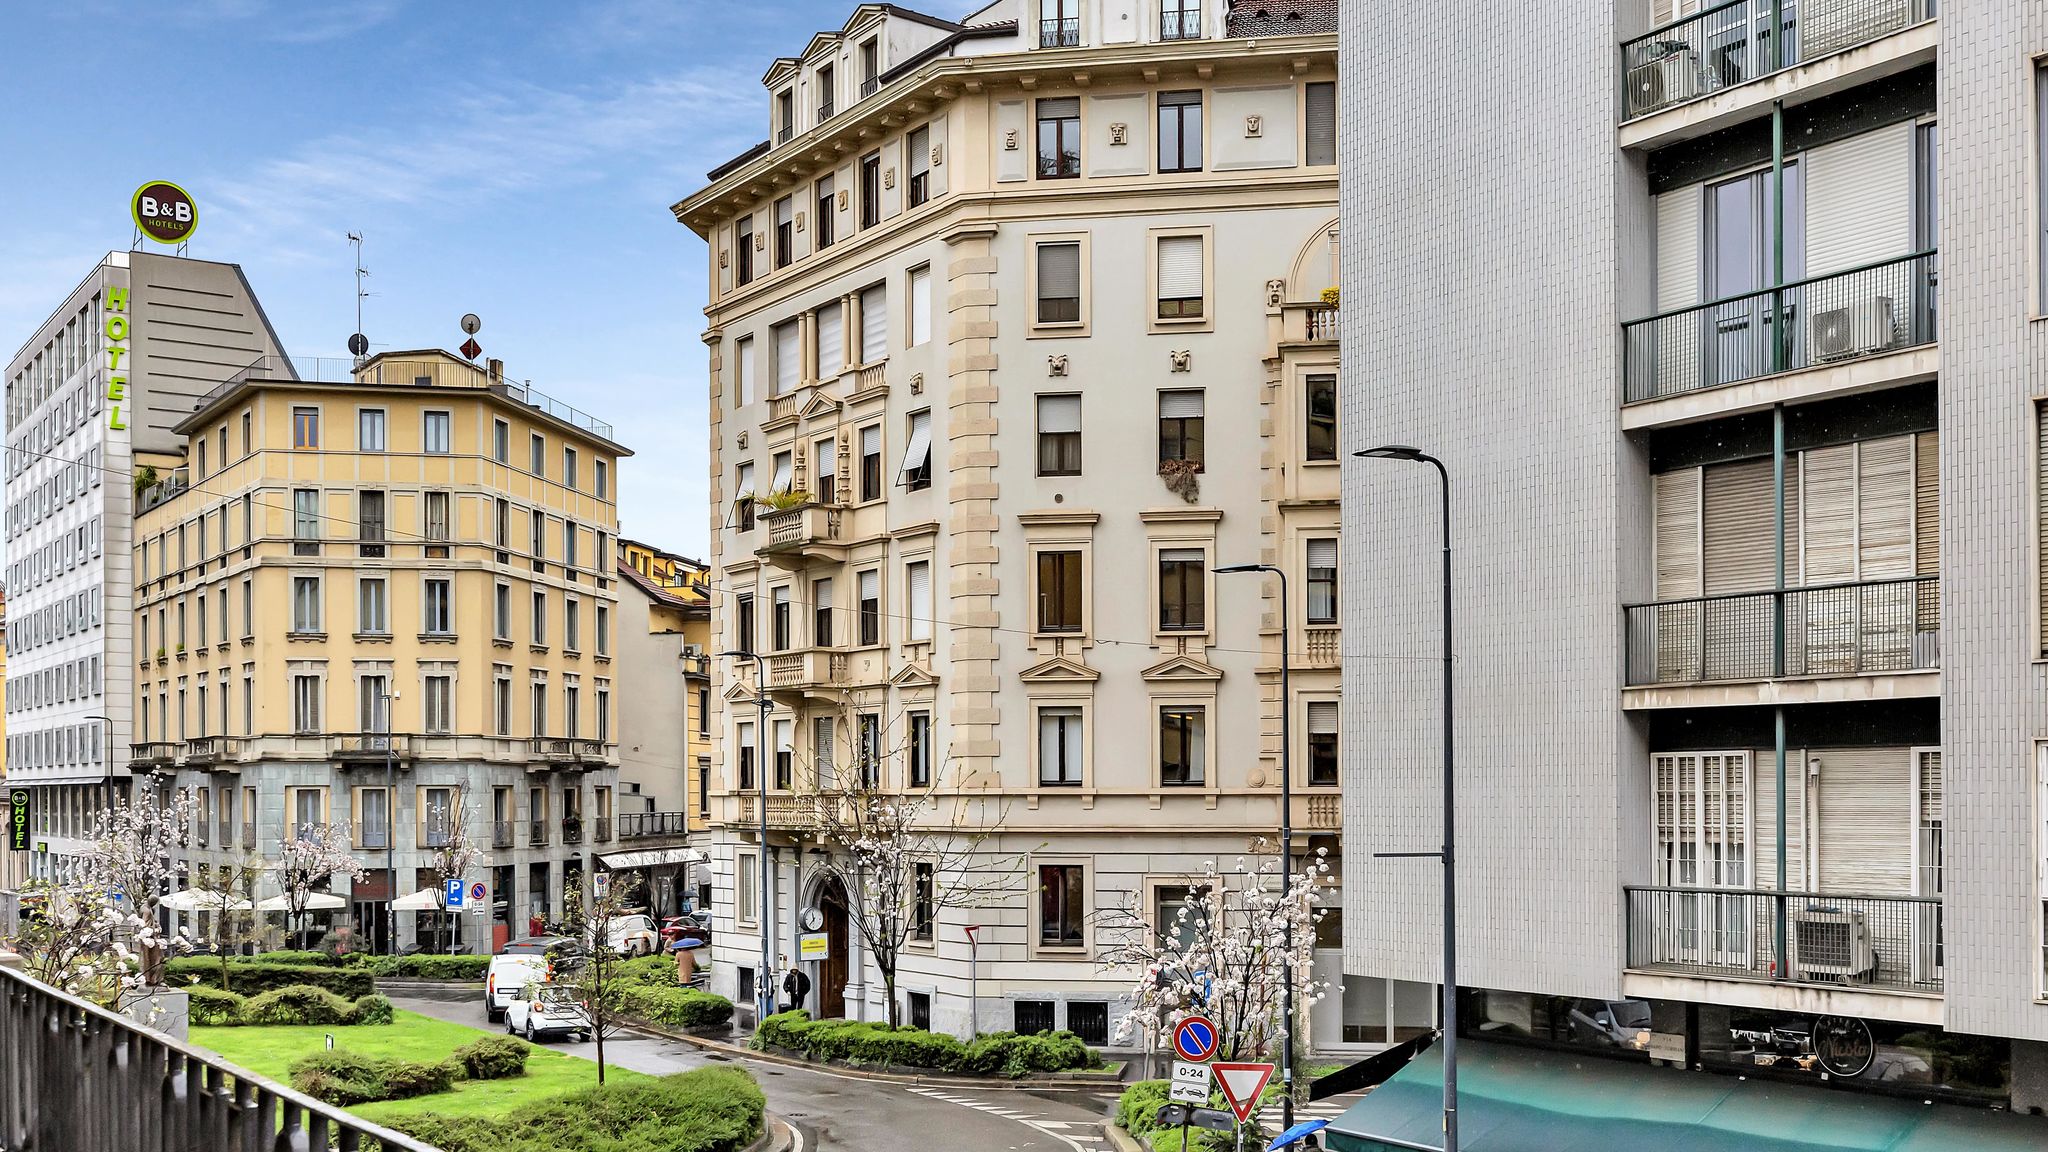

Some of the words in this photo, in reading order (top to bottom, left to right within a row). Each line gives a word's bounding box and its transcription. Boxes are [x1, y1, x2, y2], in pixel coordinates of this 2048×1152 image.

[142, 196, 192, 222] B&B
[148, 219, 184, 231] HOTELS
[105, 285, 128, 430] HOTEL
[14, 806, 25, 849] HOTEL
[450, 881, 461, 894] P
[1179, 1067, 1204, 1078] 0-24
